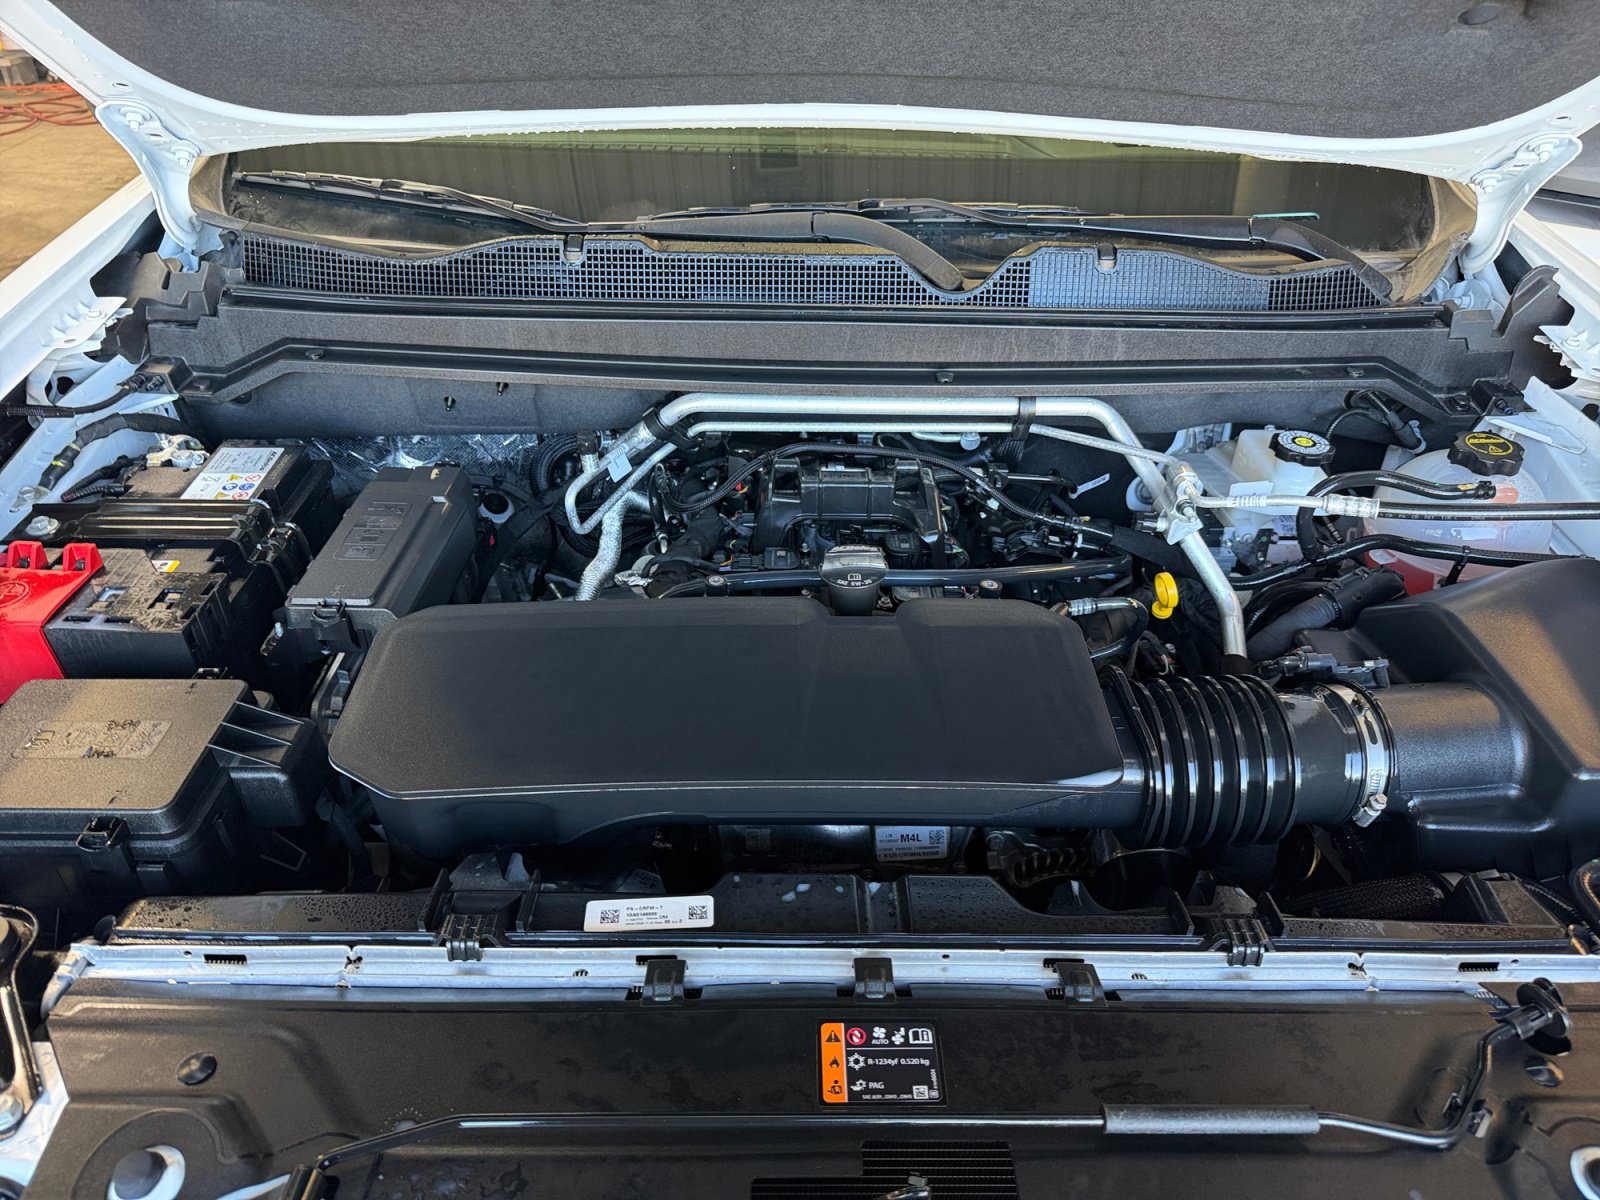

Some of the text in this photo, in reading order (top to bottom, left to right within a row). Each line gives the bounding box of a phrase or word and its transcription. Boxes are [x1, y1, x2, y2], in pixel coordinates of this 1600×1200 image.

[900, 833, 922, 843] M4L
[867, 1057, 898, 1066] R-1234yf
[920, 1057, 930, 1066] kg
[868, 1081, 885, 1089] PAG
